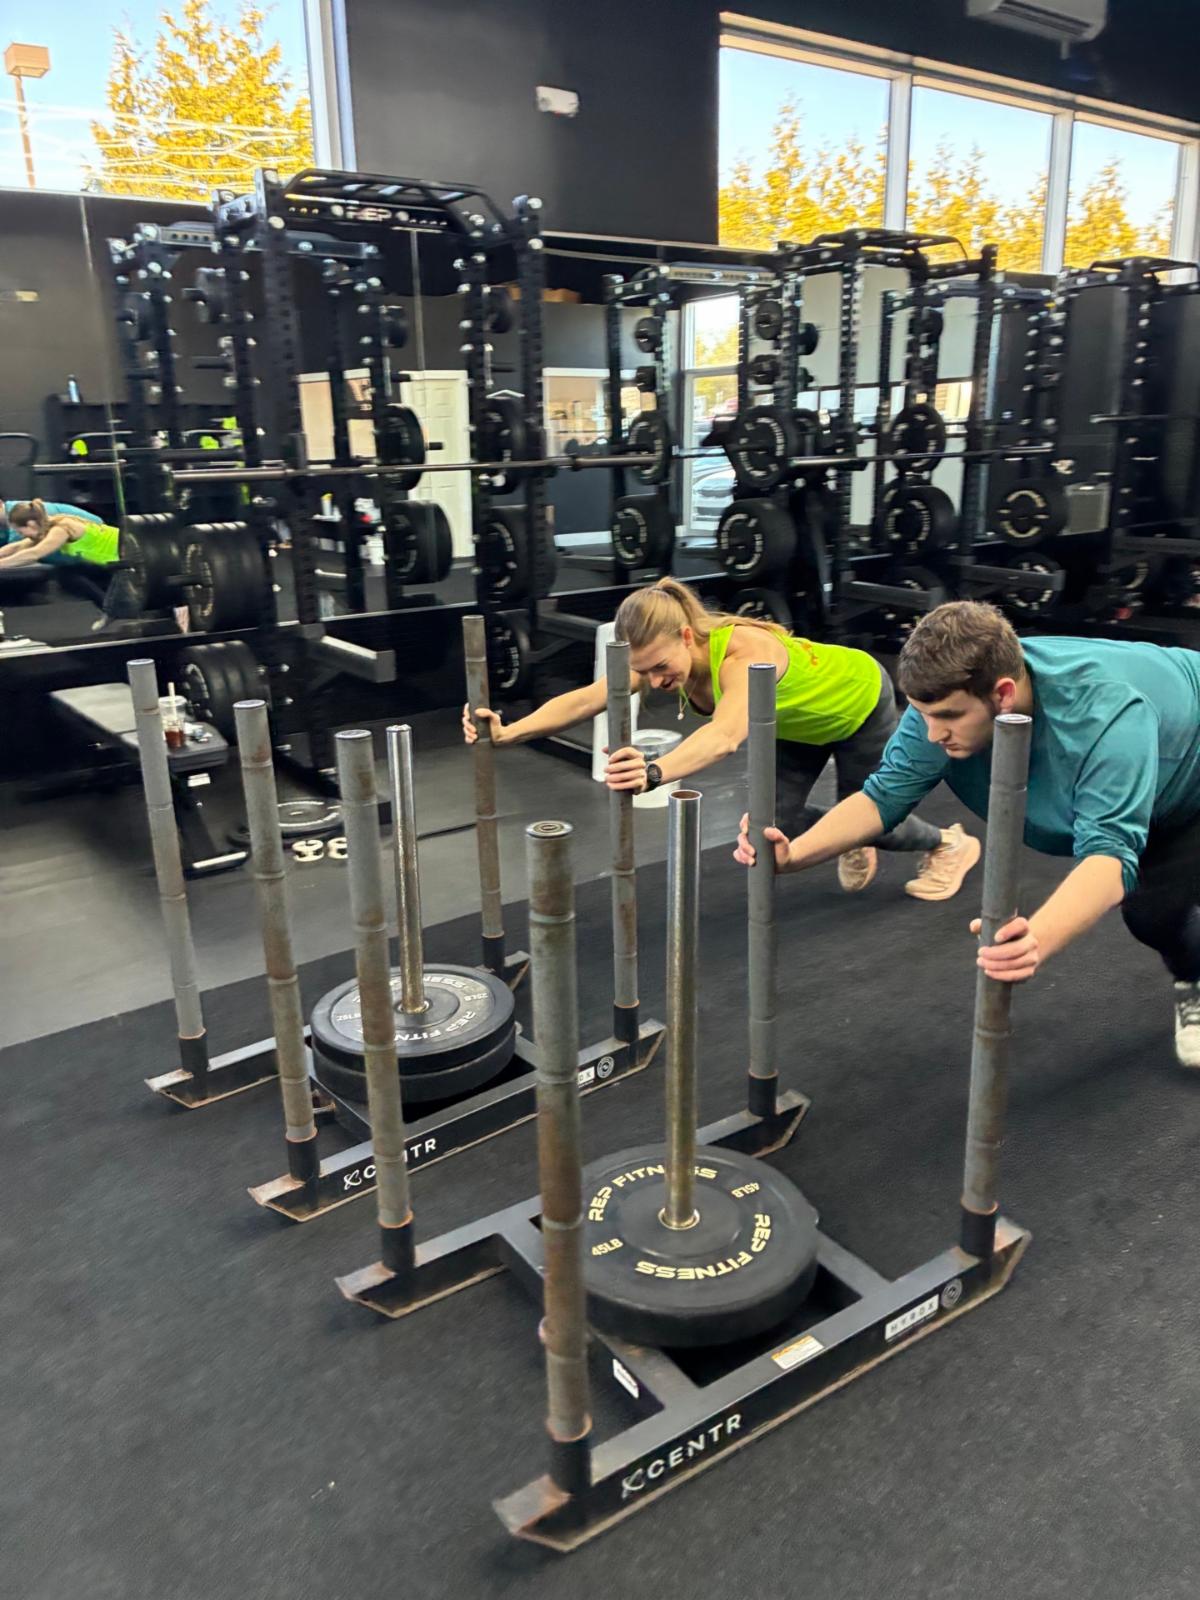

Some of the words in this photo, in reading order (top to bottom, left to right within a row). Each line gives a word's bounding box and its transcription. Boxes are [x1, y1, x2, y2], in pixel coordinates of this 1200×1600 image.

[588, 1186, 613, 1222] REP
[731, 1182, 761, 1199] 45LB
[591, 1237, 624, 1257] 45LB
[751, 1213, 772, 1253] REP
[634, 1251, 754, 1281] FITNESS
[647, 1413, 742, 1479] CENTR
